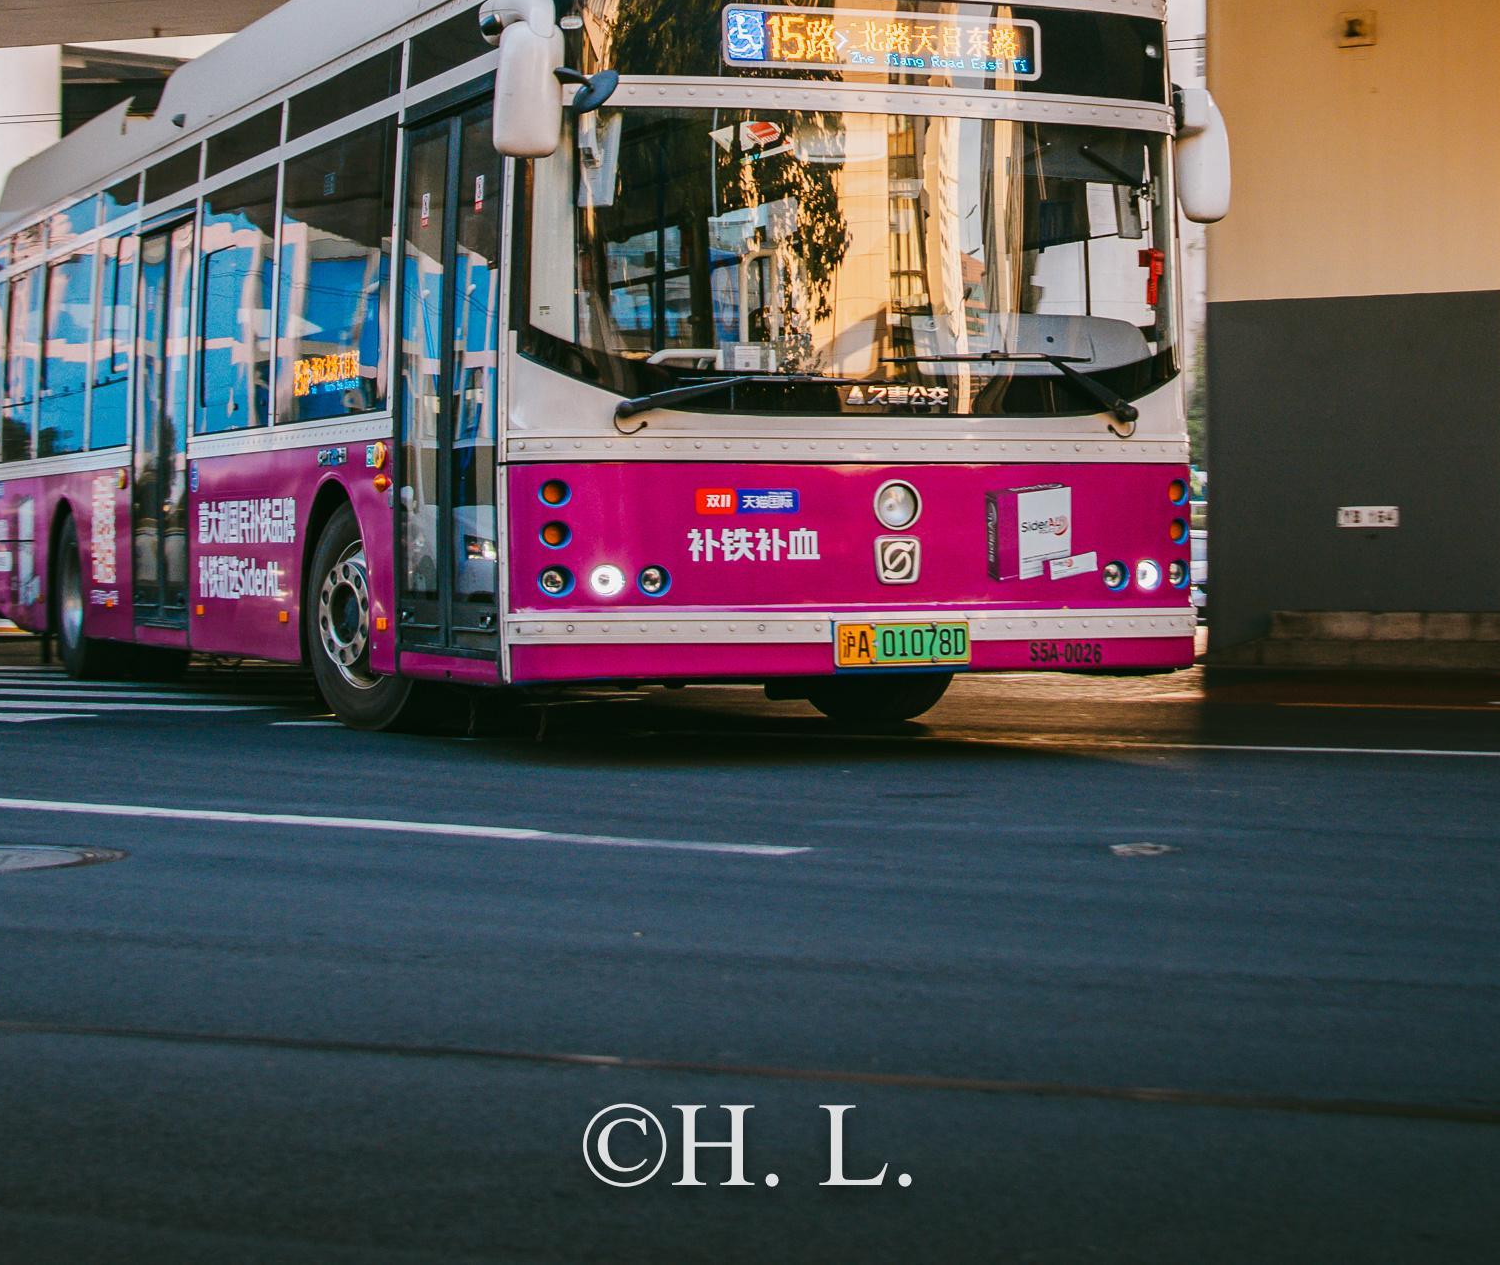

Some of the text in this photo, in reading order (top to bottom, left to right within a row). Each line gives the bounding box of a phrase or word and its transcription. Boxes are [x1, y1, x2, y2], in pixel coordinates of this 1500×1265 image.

[767, 14, 836, 61] 15路
[850, 51, 876, 65] Zhe
[884, 53, 925, 69] Jiang
[931, 55, 965, 69] Road
[971, 57, 1004, 71] East
[867, 385, 949, 405] 久事公交
[687, 527, 821, 562] 补铁补血
[1029, 642, 1102, 664] S5A-0026
